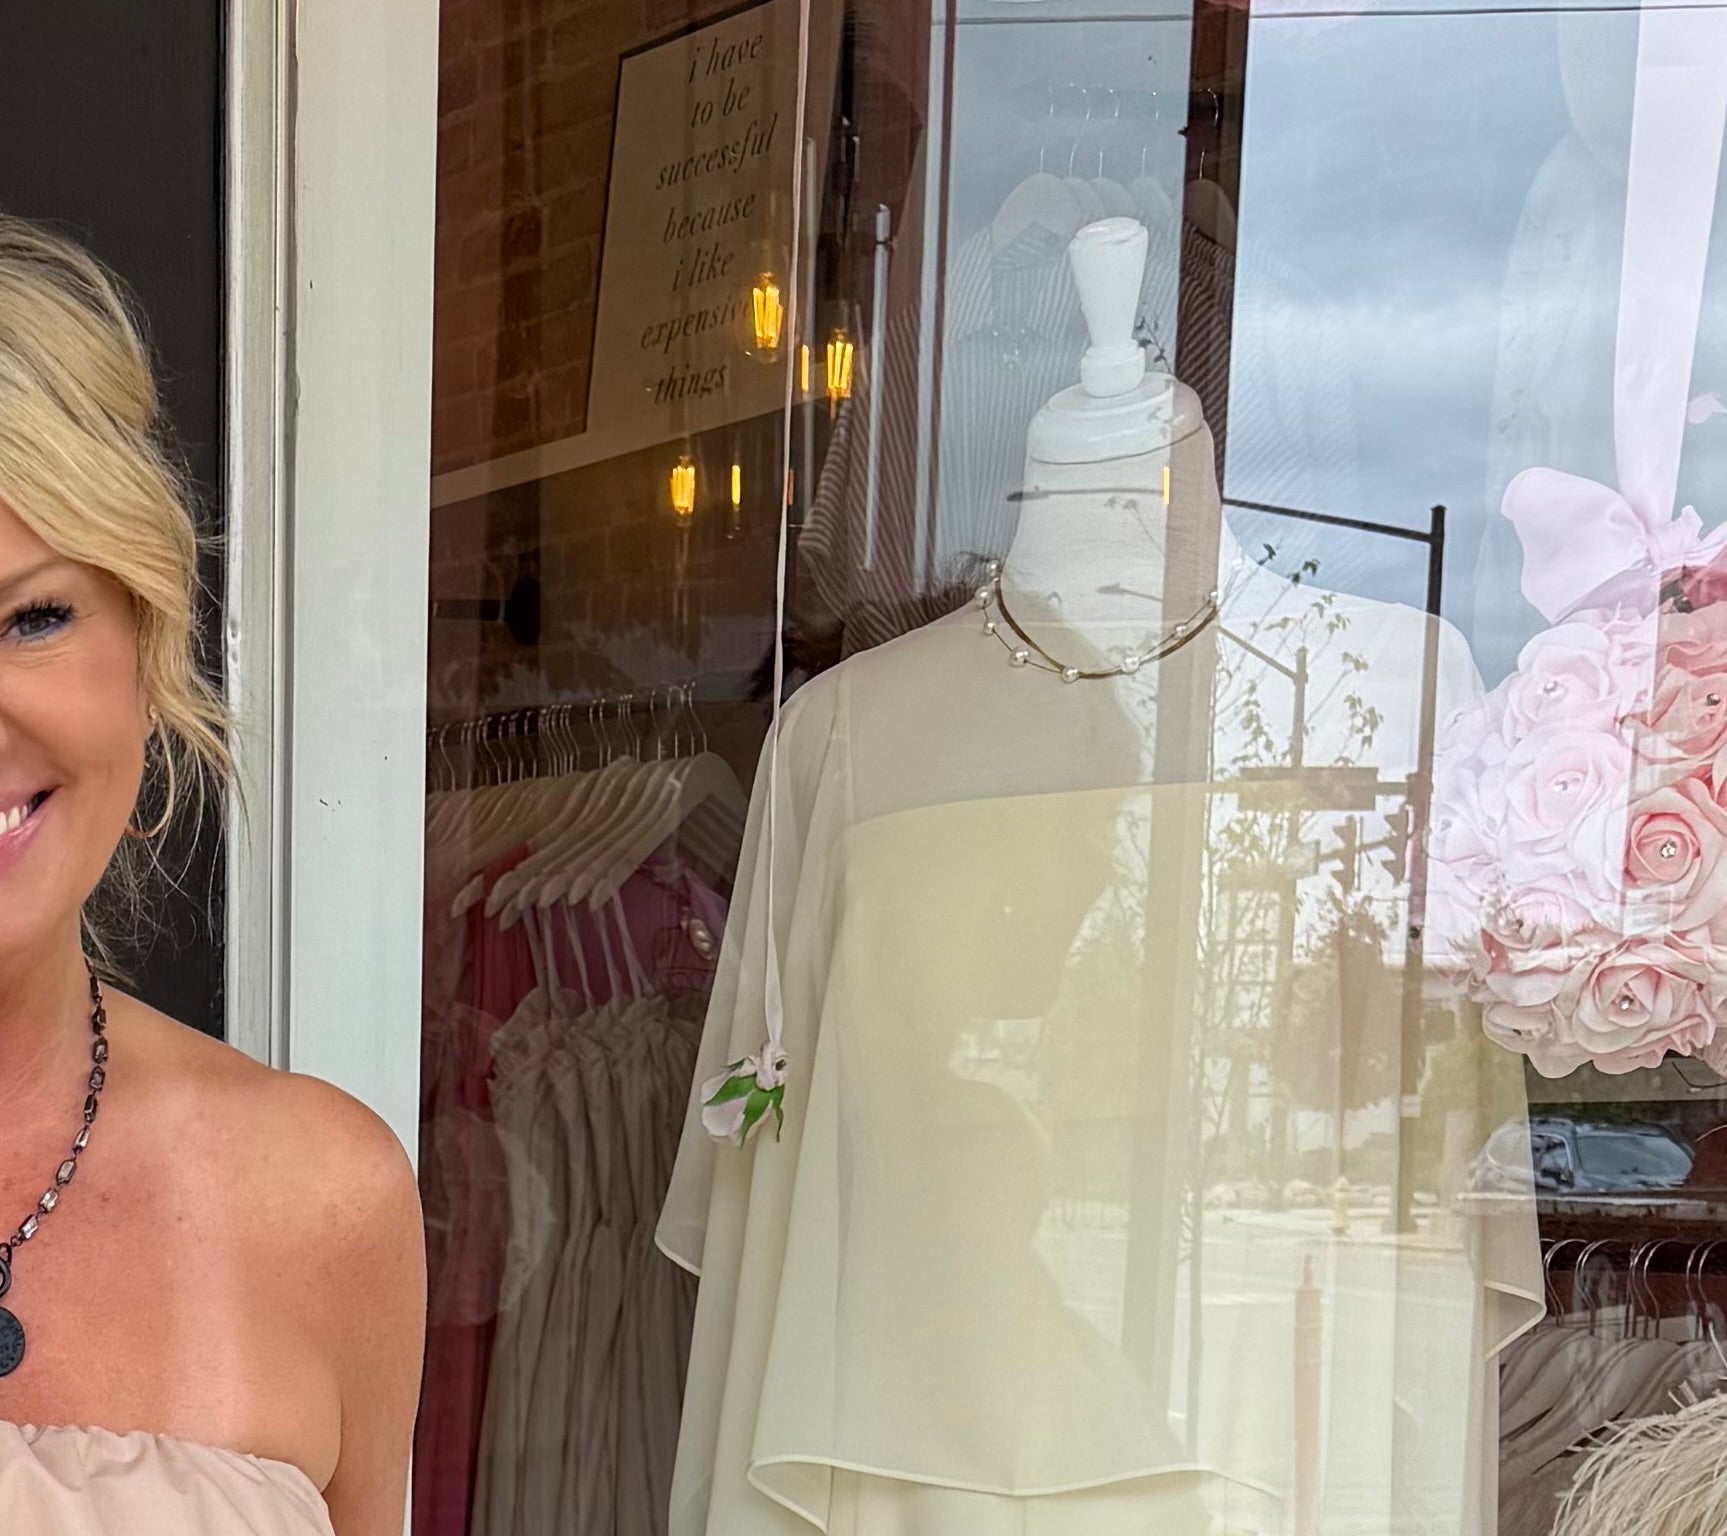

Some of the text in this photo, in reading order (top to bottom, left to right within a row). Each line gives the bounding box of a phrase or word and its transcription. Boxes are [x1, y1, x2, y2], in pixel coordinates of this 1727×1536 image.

[688, 35, 763, 84] i have
[692, 78, 752, 129] to be
[656, 113, 779, 190] successful
[663, 192, 756, 245] because
[672, 242, 734, 292] i like
[653, 363, 727, 405] things
